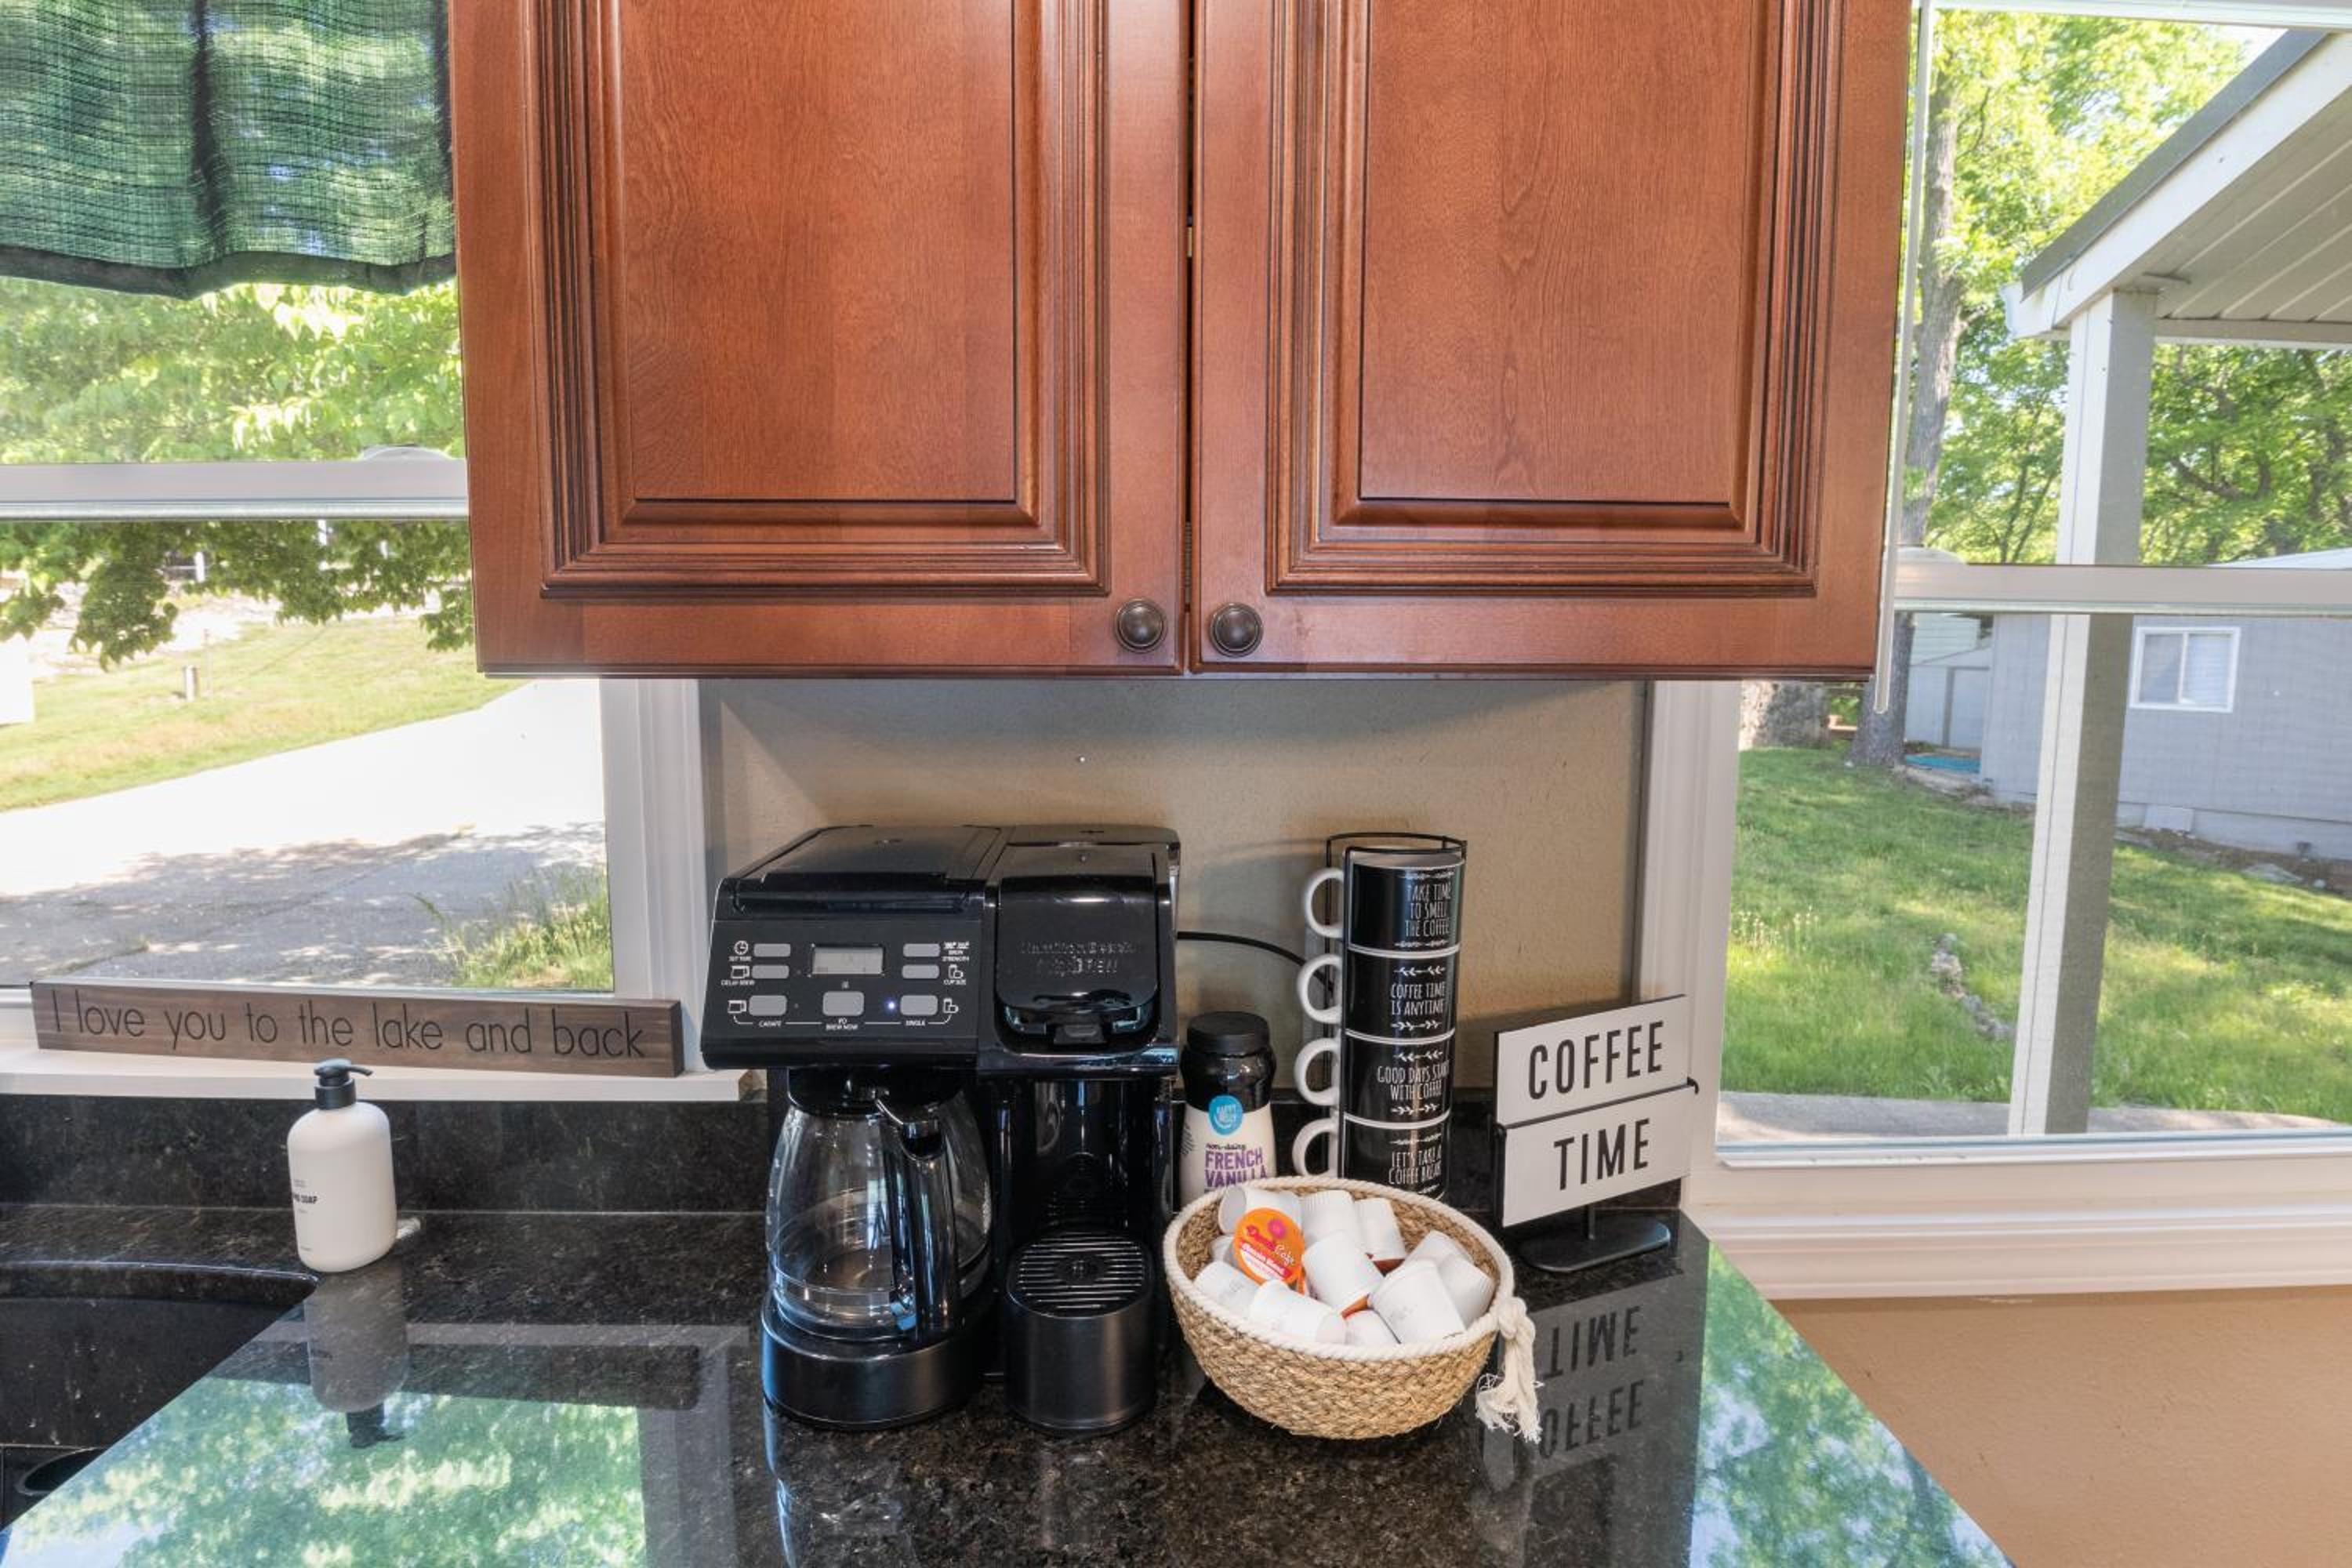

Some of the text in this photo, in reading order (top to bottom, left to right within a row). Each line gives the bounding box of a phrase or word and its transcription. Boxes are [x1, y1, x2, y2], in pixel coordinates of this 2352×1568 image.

[1406, 882, 1451, 902] TAKE TIME
[1410, 902, 1421, 920] TO
[1405, 917, 1450, 937] THE COFFEE
[1390, 981, 1445, 999] COFFEE TIME
[1392, 999, 1445, 1016] IS ANYTIME
[53, 989, 645, 1058] I love you to the lake and back
[1527, 1020, 1664, 1100] COFFEE
[1377, 1065, 1406, 1084] GOOD
[1408, 1065, 1431, 1083] DAYS
[1390, 1083, 1414, 1101] WITH
[1205, 1146, 1263, 1170] FRENCH
[1553, 1118, 1651, 1192] TIME
